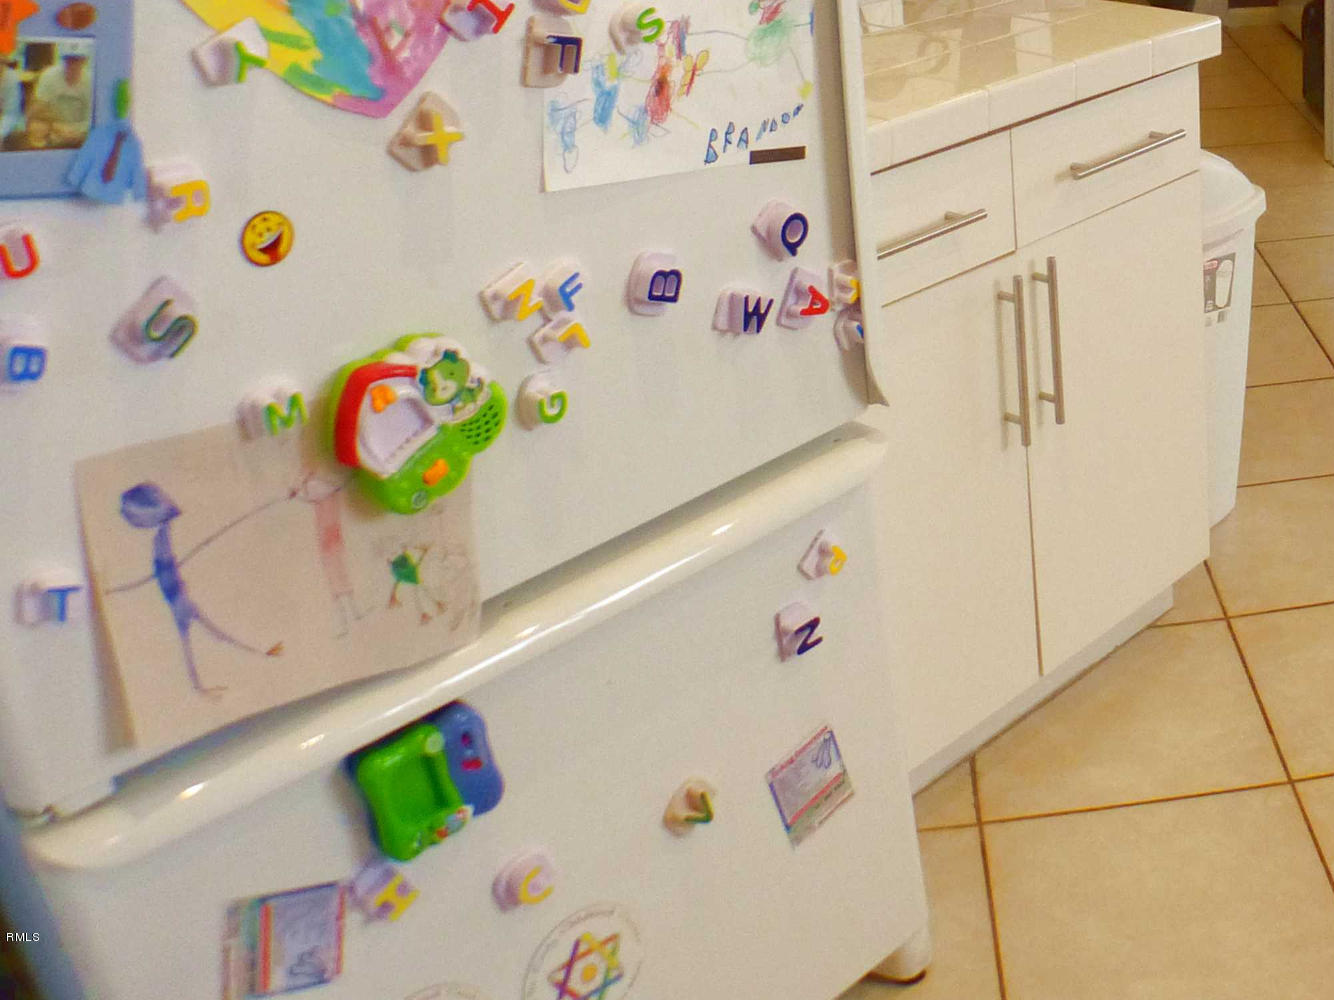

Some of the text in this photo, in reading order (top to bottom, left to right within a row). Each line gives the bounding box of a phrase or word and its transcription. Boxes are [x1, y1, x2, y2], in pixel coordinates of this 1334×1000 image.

[636, 8, 664, 43] S
[781, 213, 808, 256] Q
[558, 272, 583, 311] F
[648, 270, 681, 302] B
[800, 286, 830, 315] A
[744, 296, 773, 333] W
[7, 347, 45, 382] B
[266, 395, 306, 435] M
[47, 585, 83, 622] T
